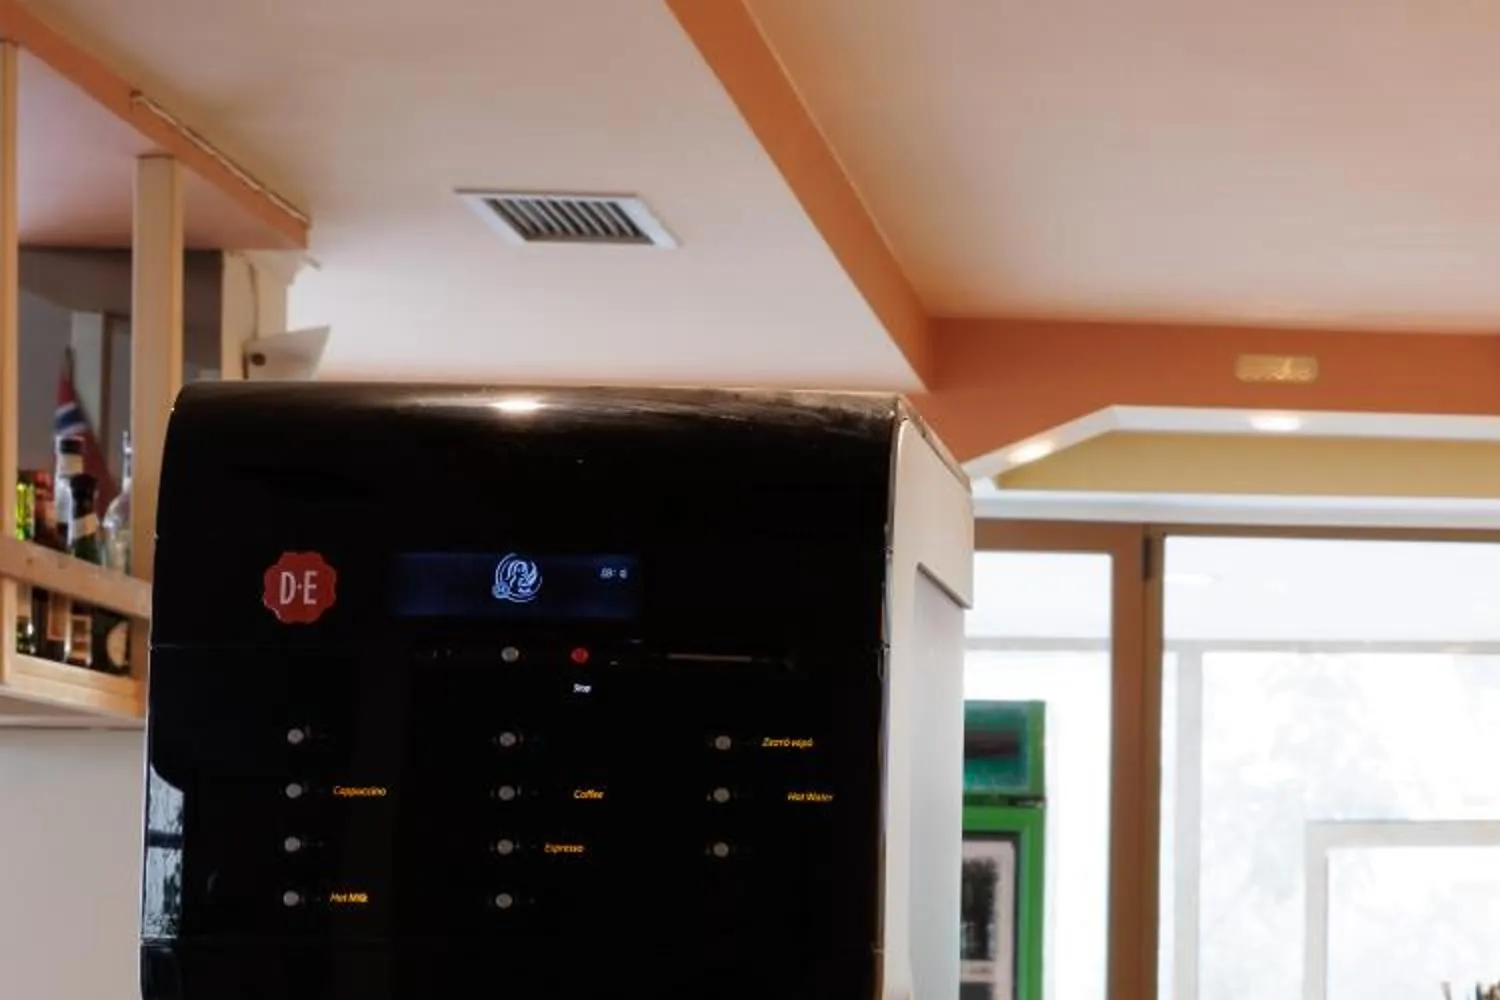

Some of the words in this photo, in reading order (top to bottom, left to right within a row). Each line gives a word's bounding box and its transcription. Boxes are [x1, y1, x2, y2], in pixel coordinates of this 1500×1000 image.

[333, 786, 387, 798] Cappuccino
[574, 789, 605, 799] Coffee
[787, 792, 805, 801] Hot
[806, 792, 833, 802] Water
[544, 842, 585, 856] Espresso
[330, 892, 348, 902] Hot
